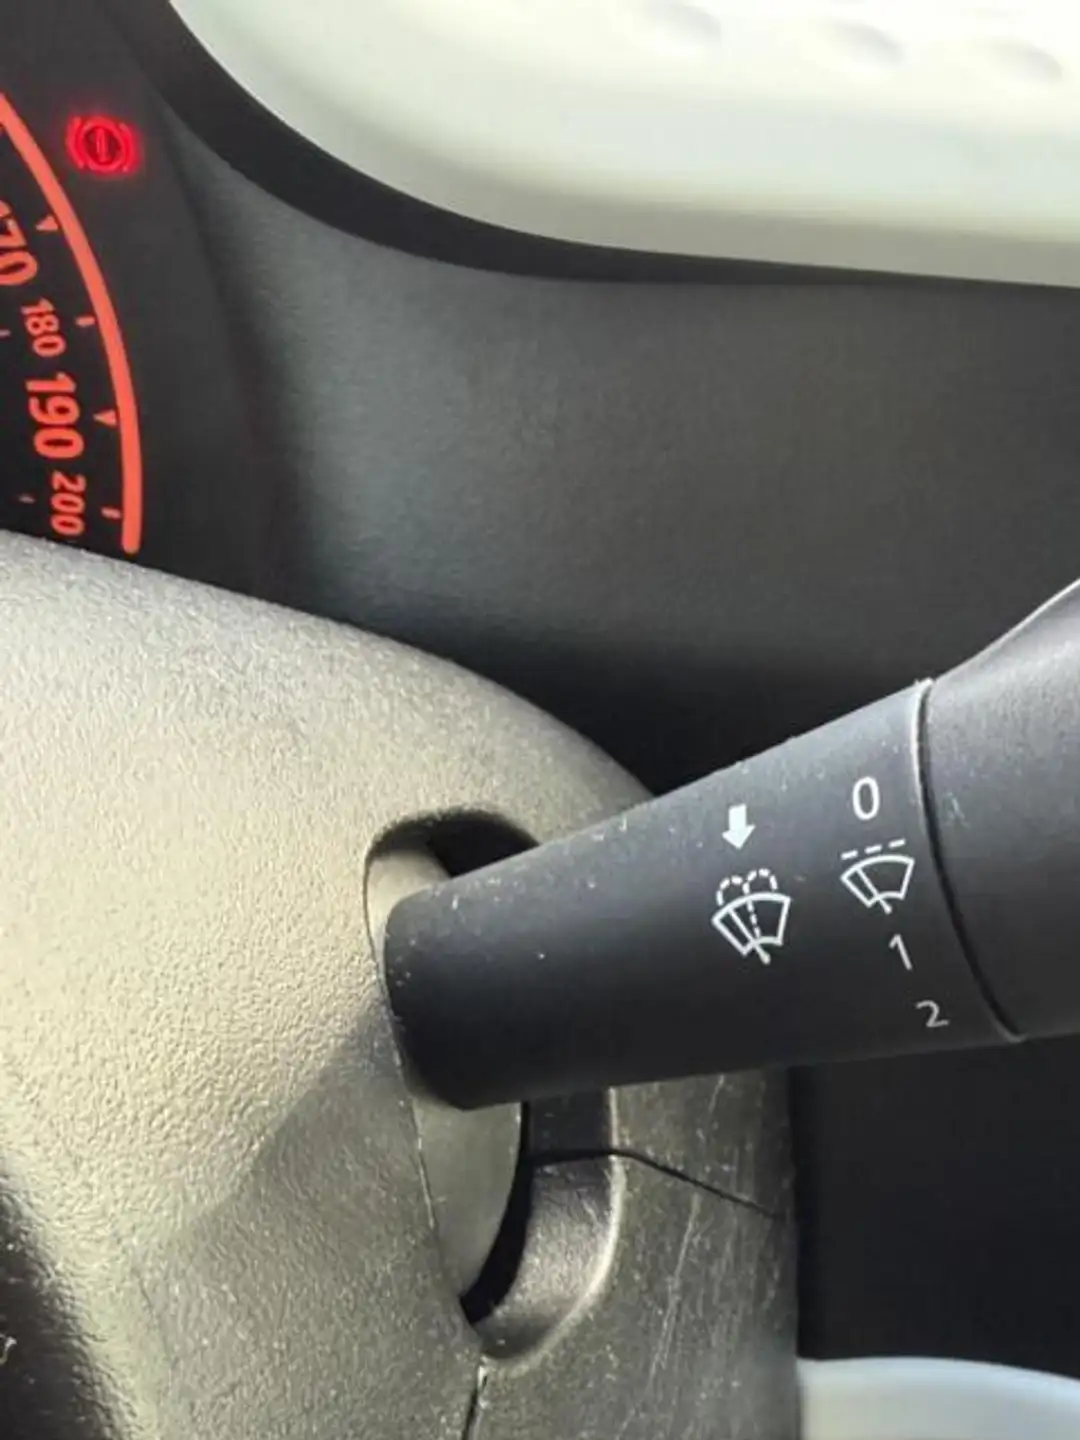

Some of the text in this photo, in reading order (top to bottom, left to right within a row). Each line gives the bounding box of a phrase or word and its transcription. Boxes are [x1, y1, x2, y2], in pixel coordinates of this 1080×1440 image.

[21, 301, 66, 357] 180
[26, 372, 85, 458] 190
[51, 471, 86, 536] 200
[853, 776, 879, 820] 0
[888, 933, 912, 971] 1
[916, 1000, 949, 1028] 2
